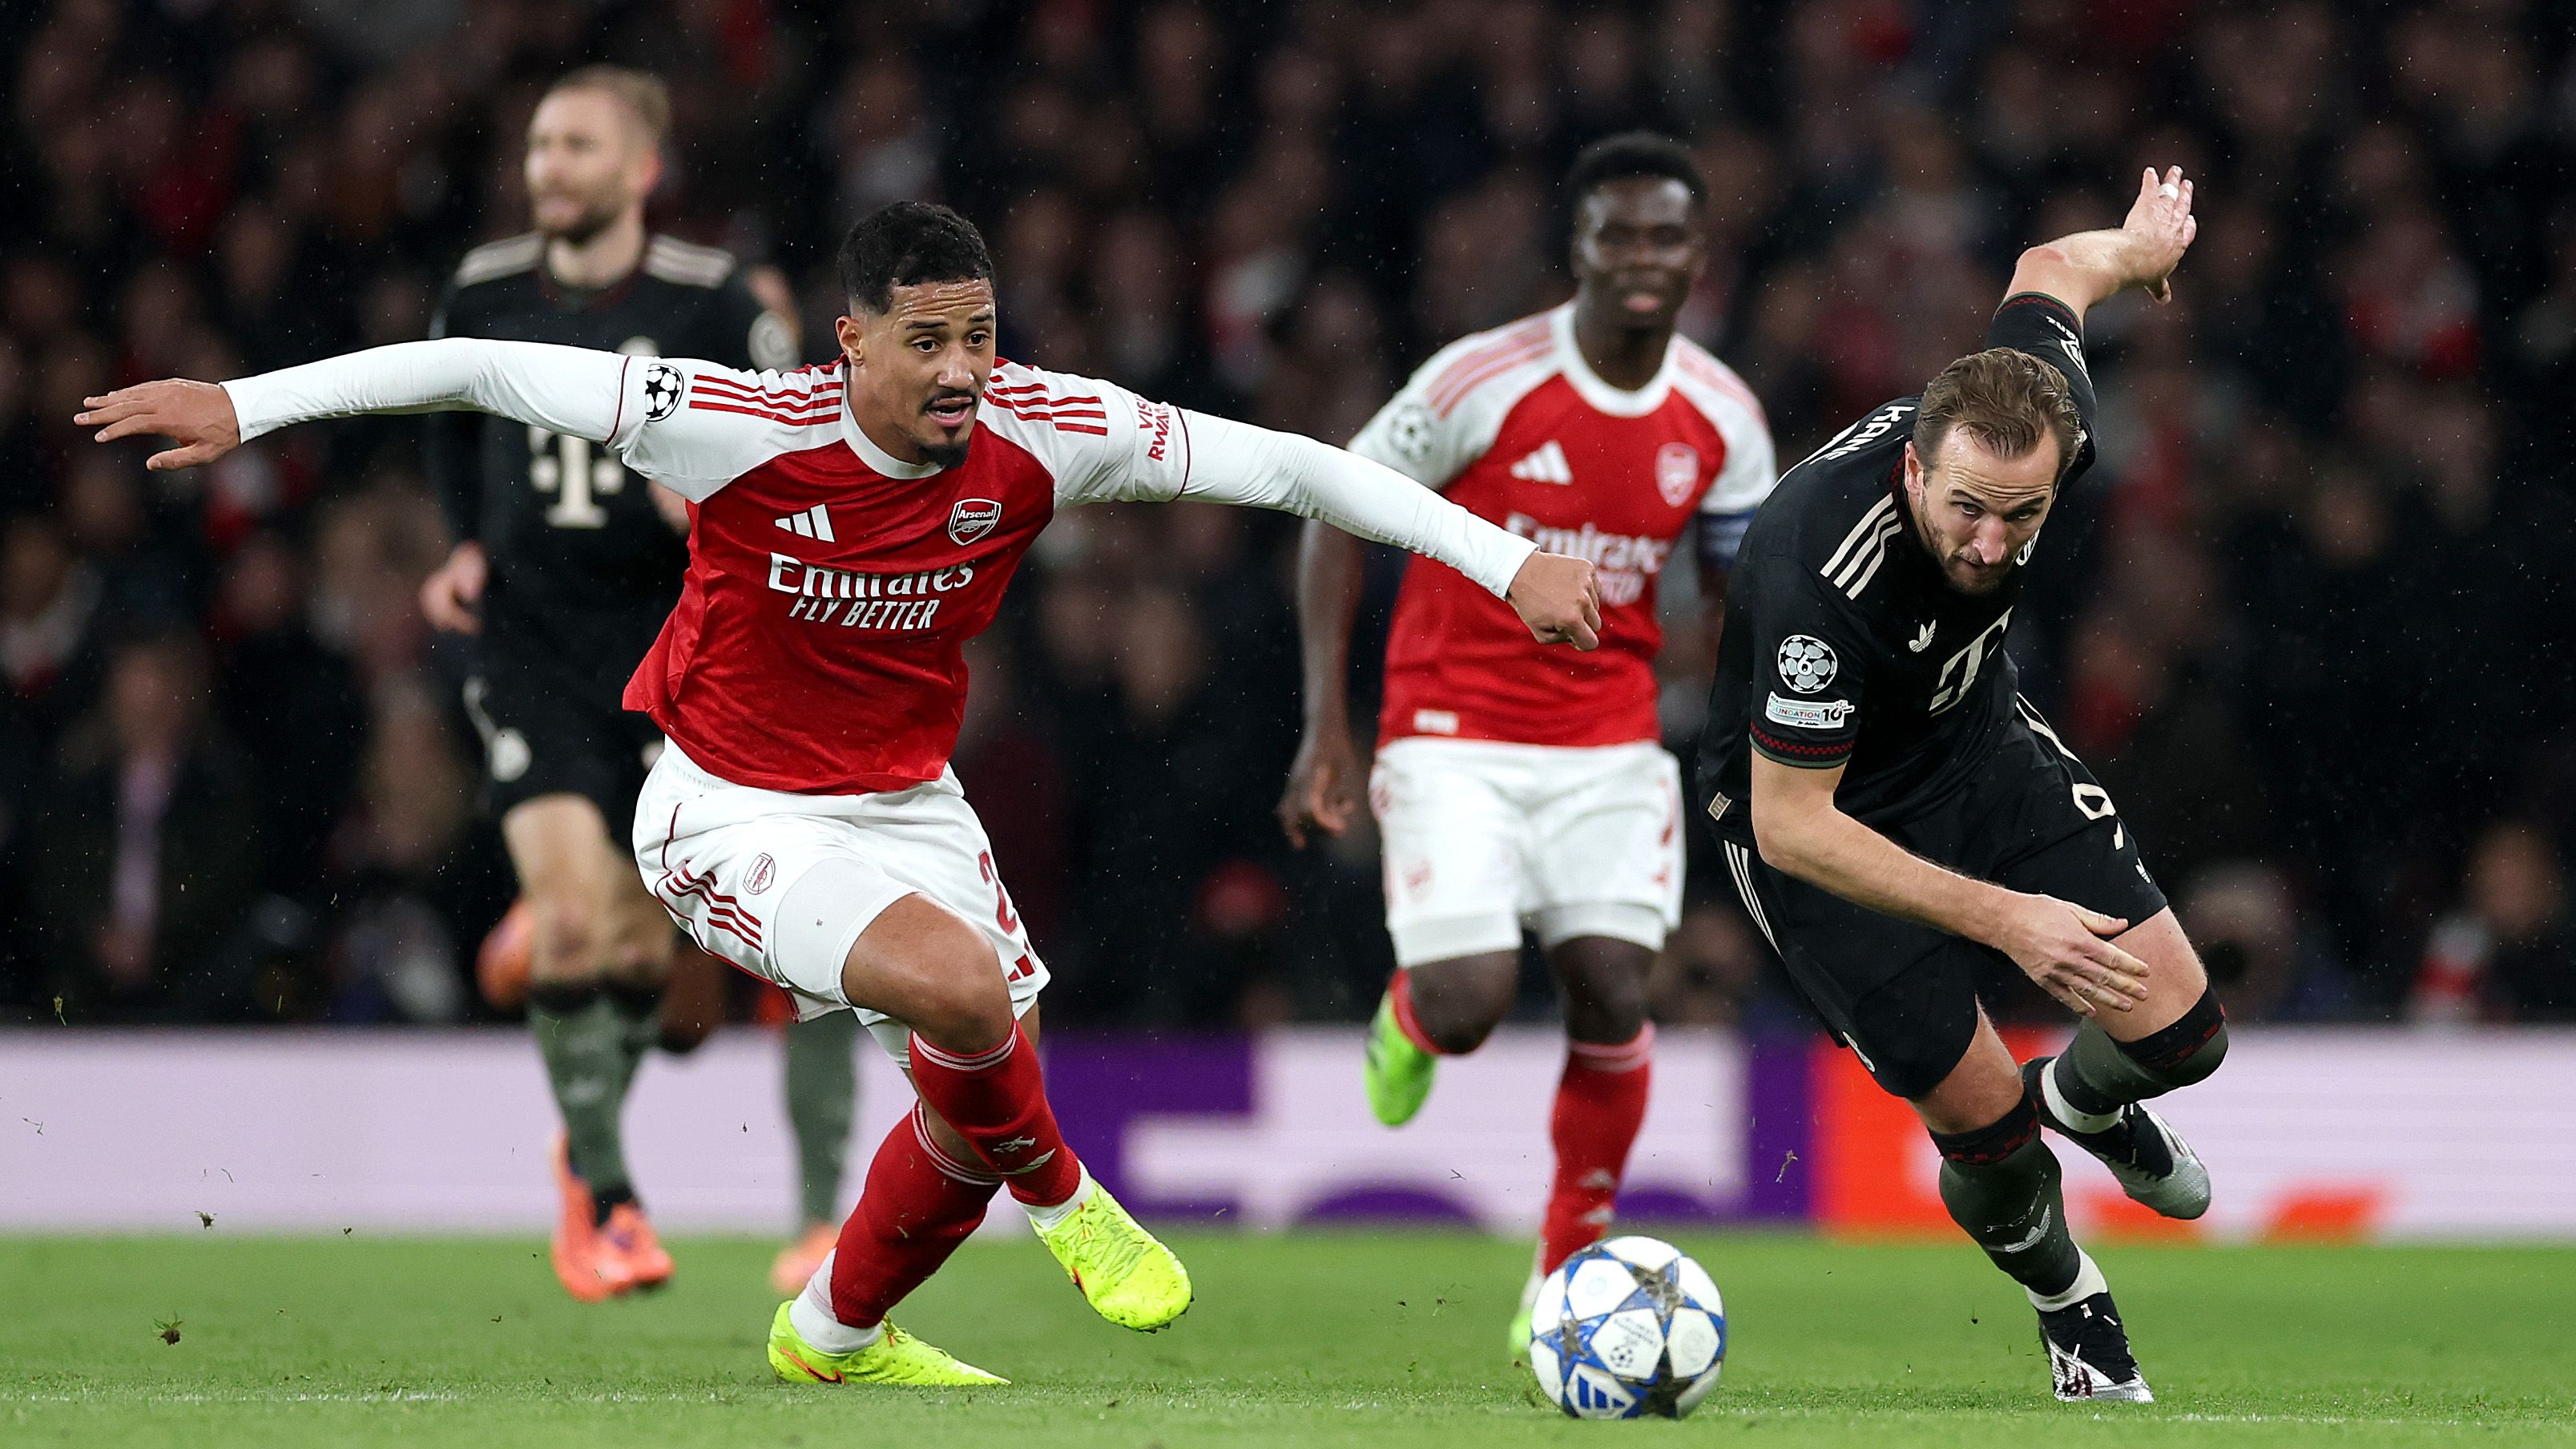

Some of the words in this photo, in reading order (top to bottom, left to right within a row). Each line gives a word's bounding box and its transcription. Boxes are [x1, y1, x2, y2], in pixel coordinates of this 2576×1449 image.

[958, 509, 994, 519] Arsenal
[789, 596, 842, 623] FLY
[841, 599, 940, 630] BETTER
[1796, 654, 1813, 676] 6
[978, 850, 1018, 937] 2
